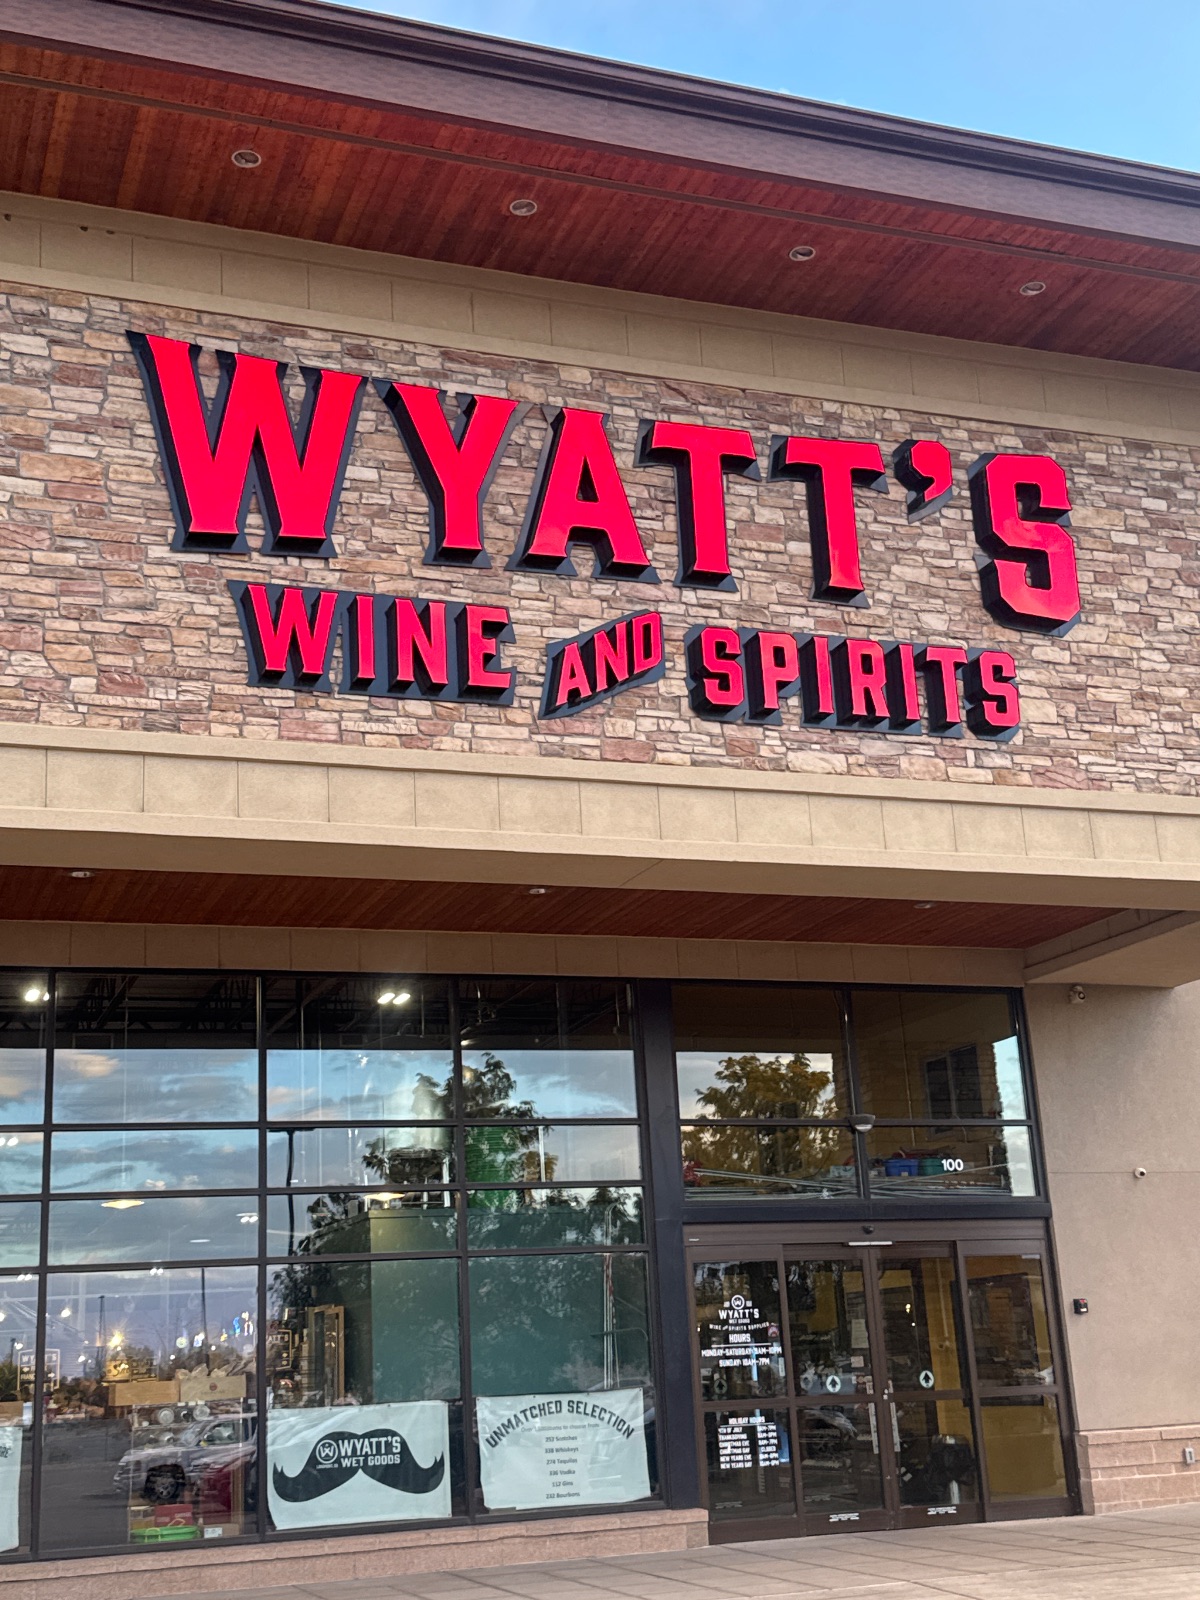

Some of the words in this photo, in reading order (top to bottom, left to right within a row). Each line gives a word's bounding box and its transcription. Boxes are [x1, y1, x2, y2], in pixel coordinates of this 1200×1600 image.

[147, 333, 1081, 623] WYATT'S
[247, 584, 512, 689] WINE
[556, 611, 662, 706] AND
[701, 626, 1020, 727] SPIRITS
[941, 1158, 964, 1171] 100
[718, 1309, 759, 1319] WYATT'S
[729, 1333, 751, 1343] HOURS
[485, 1400, 562, 1448] UNMATCHED
[567, 1399, 635, 1440] SELECTION
[339, 1436, 401, 1456] WYATT'S
[341, 1456, 366, 1468] WET
[367, 1454, 401, 1467] GOODS
